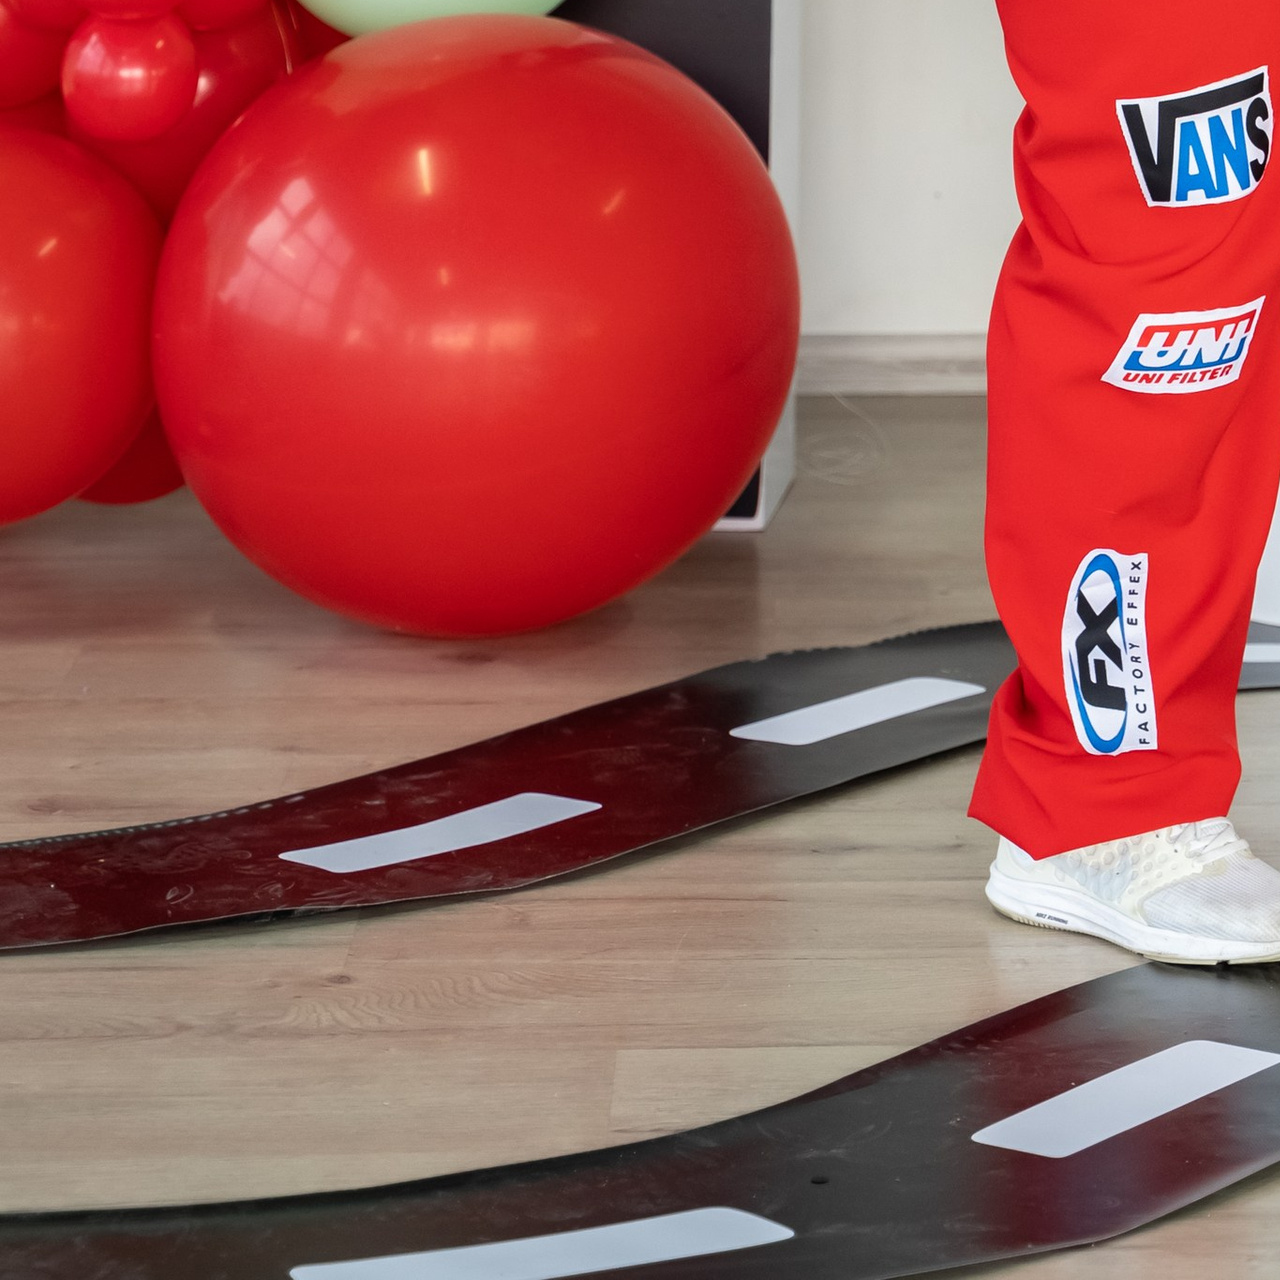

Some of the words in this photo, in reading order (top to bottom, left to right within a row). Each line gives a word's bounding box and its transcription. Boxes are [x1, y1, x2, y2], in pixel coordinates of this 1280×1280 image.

[1121, 72, 1270, 202] VANS
[1122, 372, 1165, 384] UNI
[1166, 363, 1234, 384] FILTER
[1138, 317, 1251, 368] UNI
[1126, 560, 1143, 626] EFFEX
[1075, 589, 1127, 712] FX
[1128, 642, 1151, 745] FACTORY
